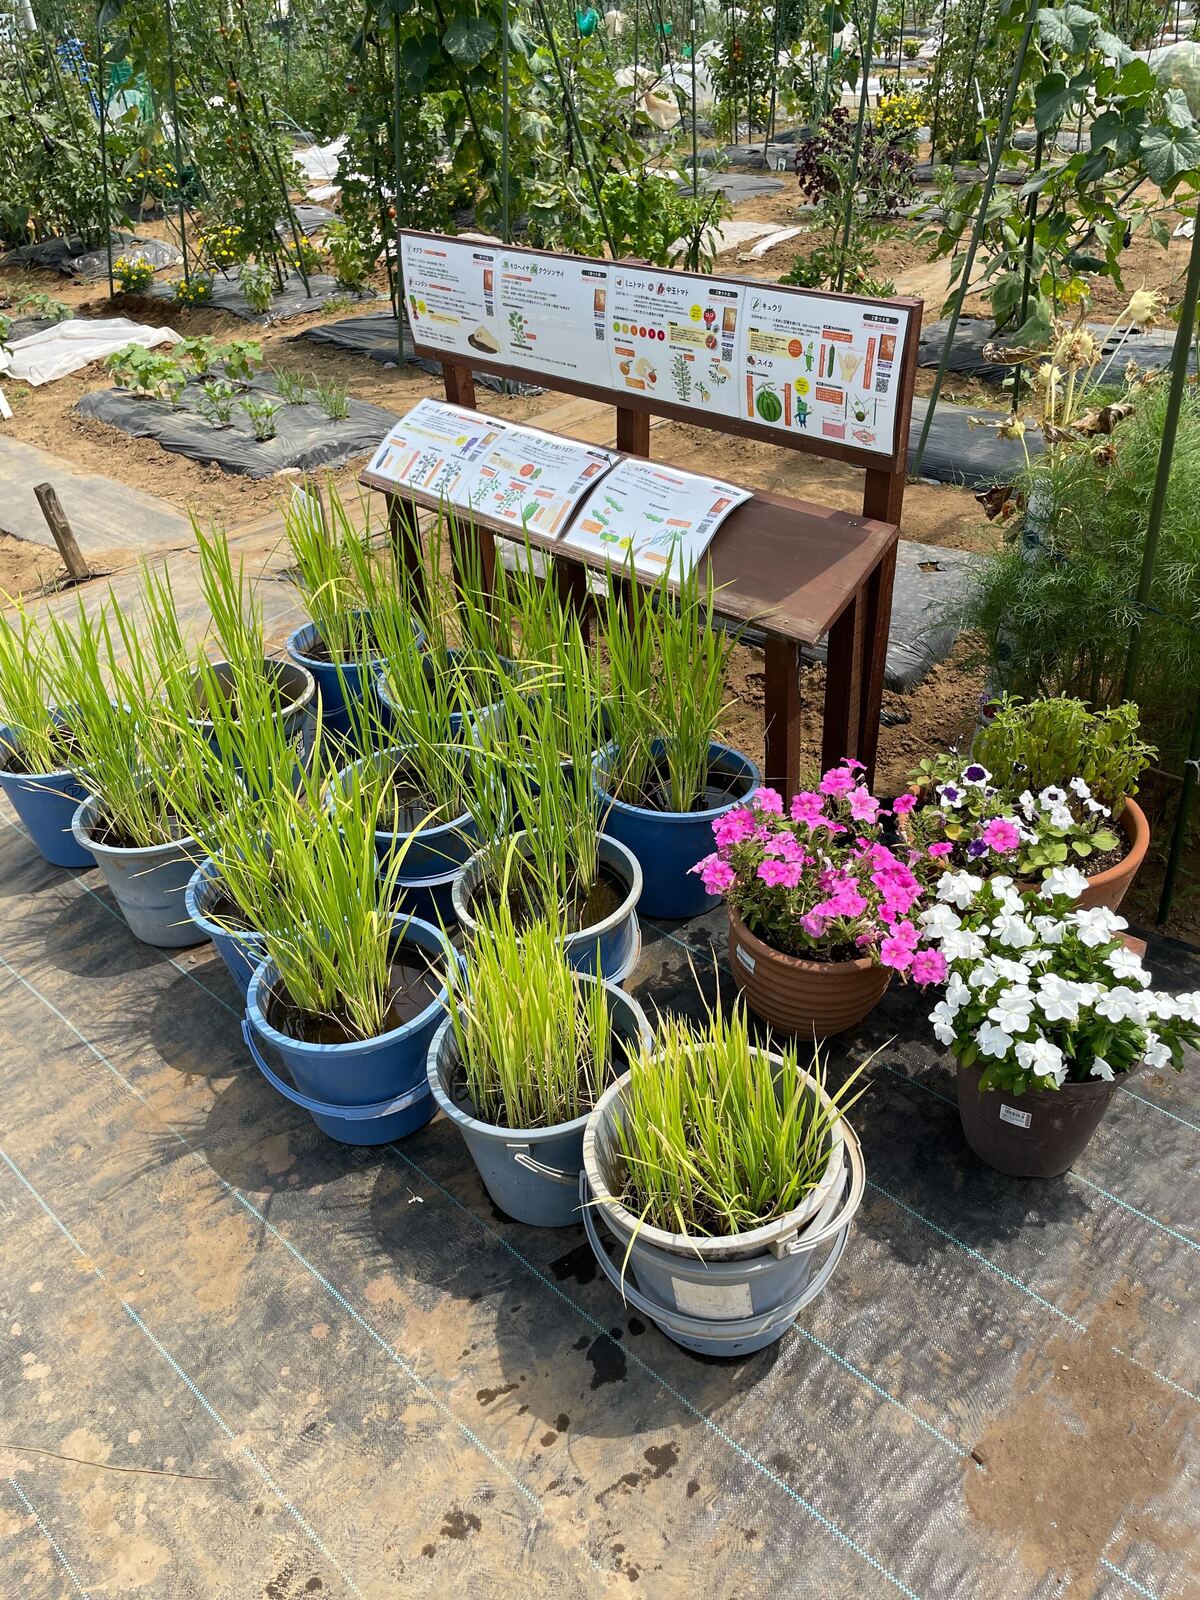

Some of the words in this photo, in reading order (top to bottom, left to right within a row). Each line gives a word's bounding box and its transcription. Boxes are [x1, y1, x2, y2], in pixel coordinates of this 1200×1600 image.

[510, 262, 530, 272] モロヘイヤ
[625, 280, 645, 289] ミニトマト
[666, 286, 689, 296] 中玉トマト
[762, 302, 783, 313] キュウリ
[757, 359, 774, 368] スイカ
